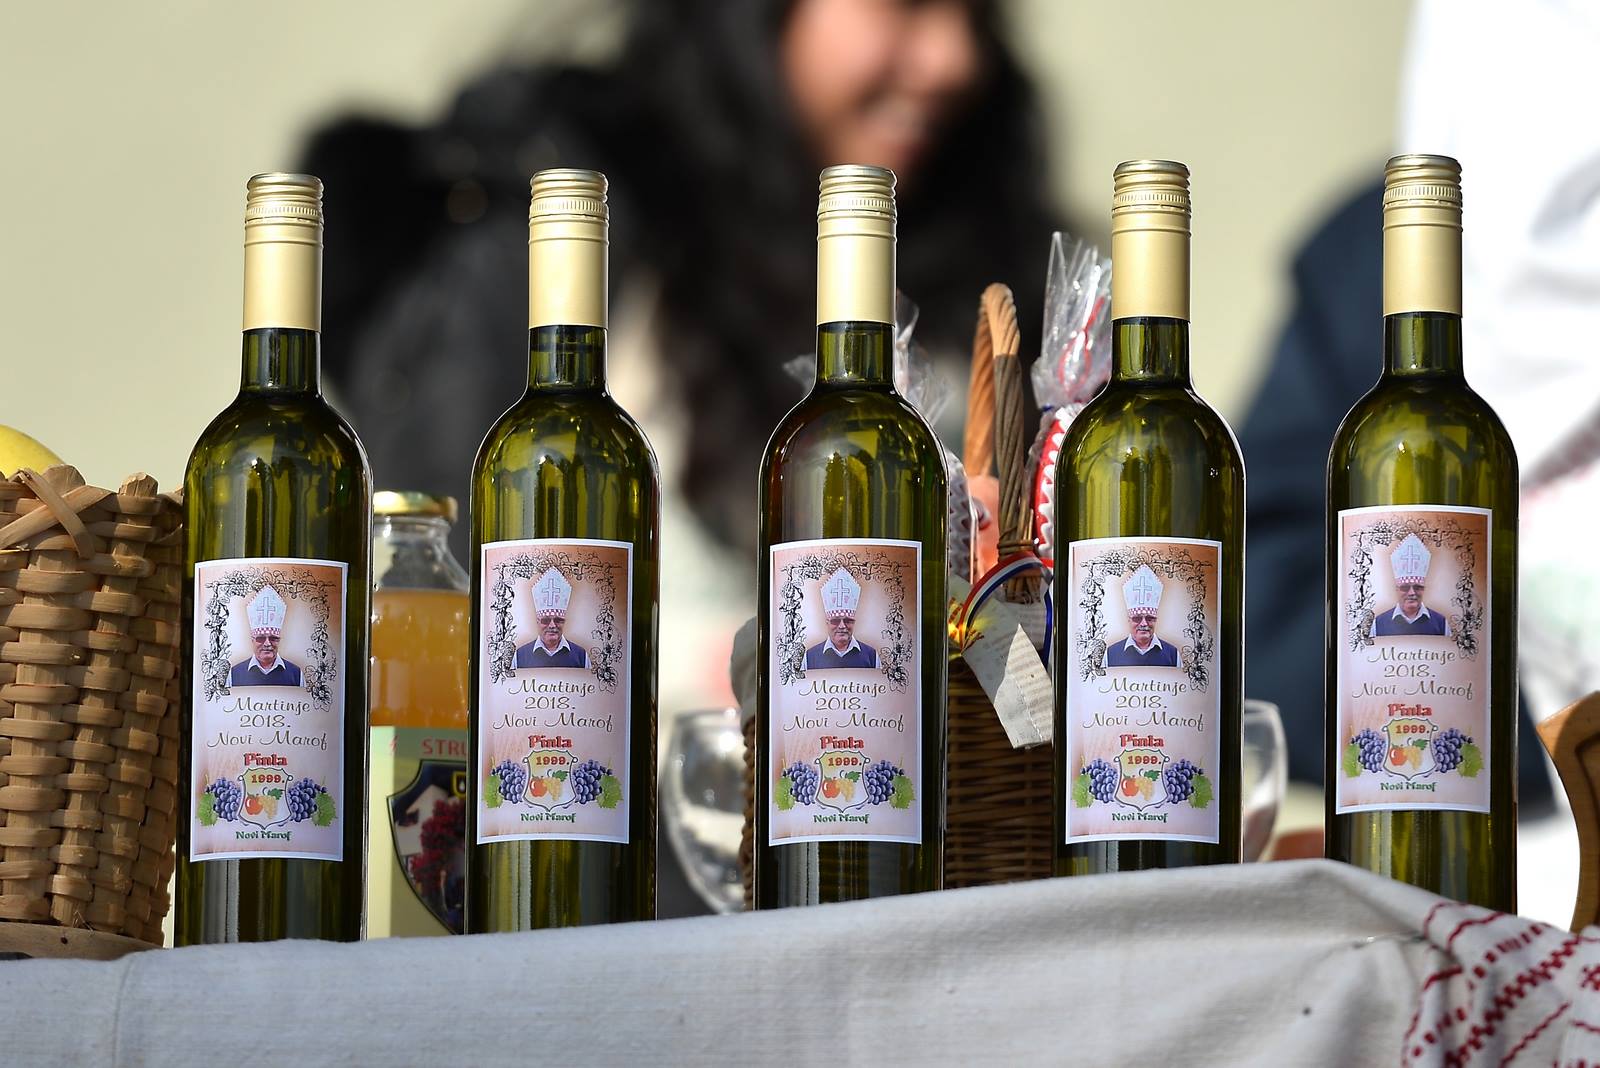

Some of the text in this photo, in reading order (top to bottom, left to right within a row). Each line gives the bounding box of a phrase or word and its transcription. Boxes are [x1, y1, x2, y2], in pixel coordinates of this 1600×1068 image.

[1368, 647, 1456, 665] Martinje
[1384, 664, 1435, 677] 2018.
[508, 679, 595, 697] Martinje
[800, 680, 886, 697] Martinje
[1100, 678, 1186, 695] Martinje
[1352, 681, 1473, 700] Novi Marof
[224, 697, 310, 715] Martinje
[525, 697, 575, 709] 2018.
[816, 698, 867, 710] 2018.
[1116, 696, 1167, 708] 2018.
[1388, 703, 1432, 716] Pinta
[240, 715, 290, 727] 2018.
[493, 713, 613, 732] Novi Marof
[784, 713, 904, 732] Novi Marof
[1083, 712, 1203, 731] Novi Marof
[1395, 725, 1429, 734] 1999.
[207, 730, 327, 750] Novi Marof
[528, 735, 572, 748] Pinta
[820, 736, 864, 749] Pinta
[1120, 734, 1164, 747] Pinta
[244, 752, 288, 766] Pinta
[536, 756, 569, 765] 1999.
[828, 757, 862, 766] 1999.
[1128, 756, 1161, 764] 1999.
[251, 775, 285, 783] 1999.
[1381, 782, 1438, 792] Novi Marof
[521, 813, 577, 822] Novi Marof
[813, 814, 870, 824] Novi Marof
[1112, 813, 1168, 823] Novi Marof
[236, 830, 292, 841] Novi Marof
